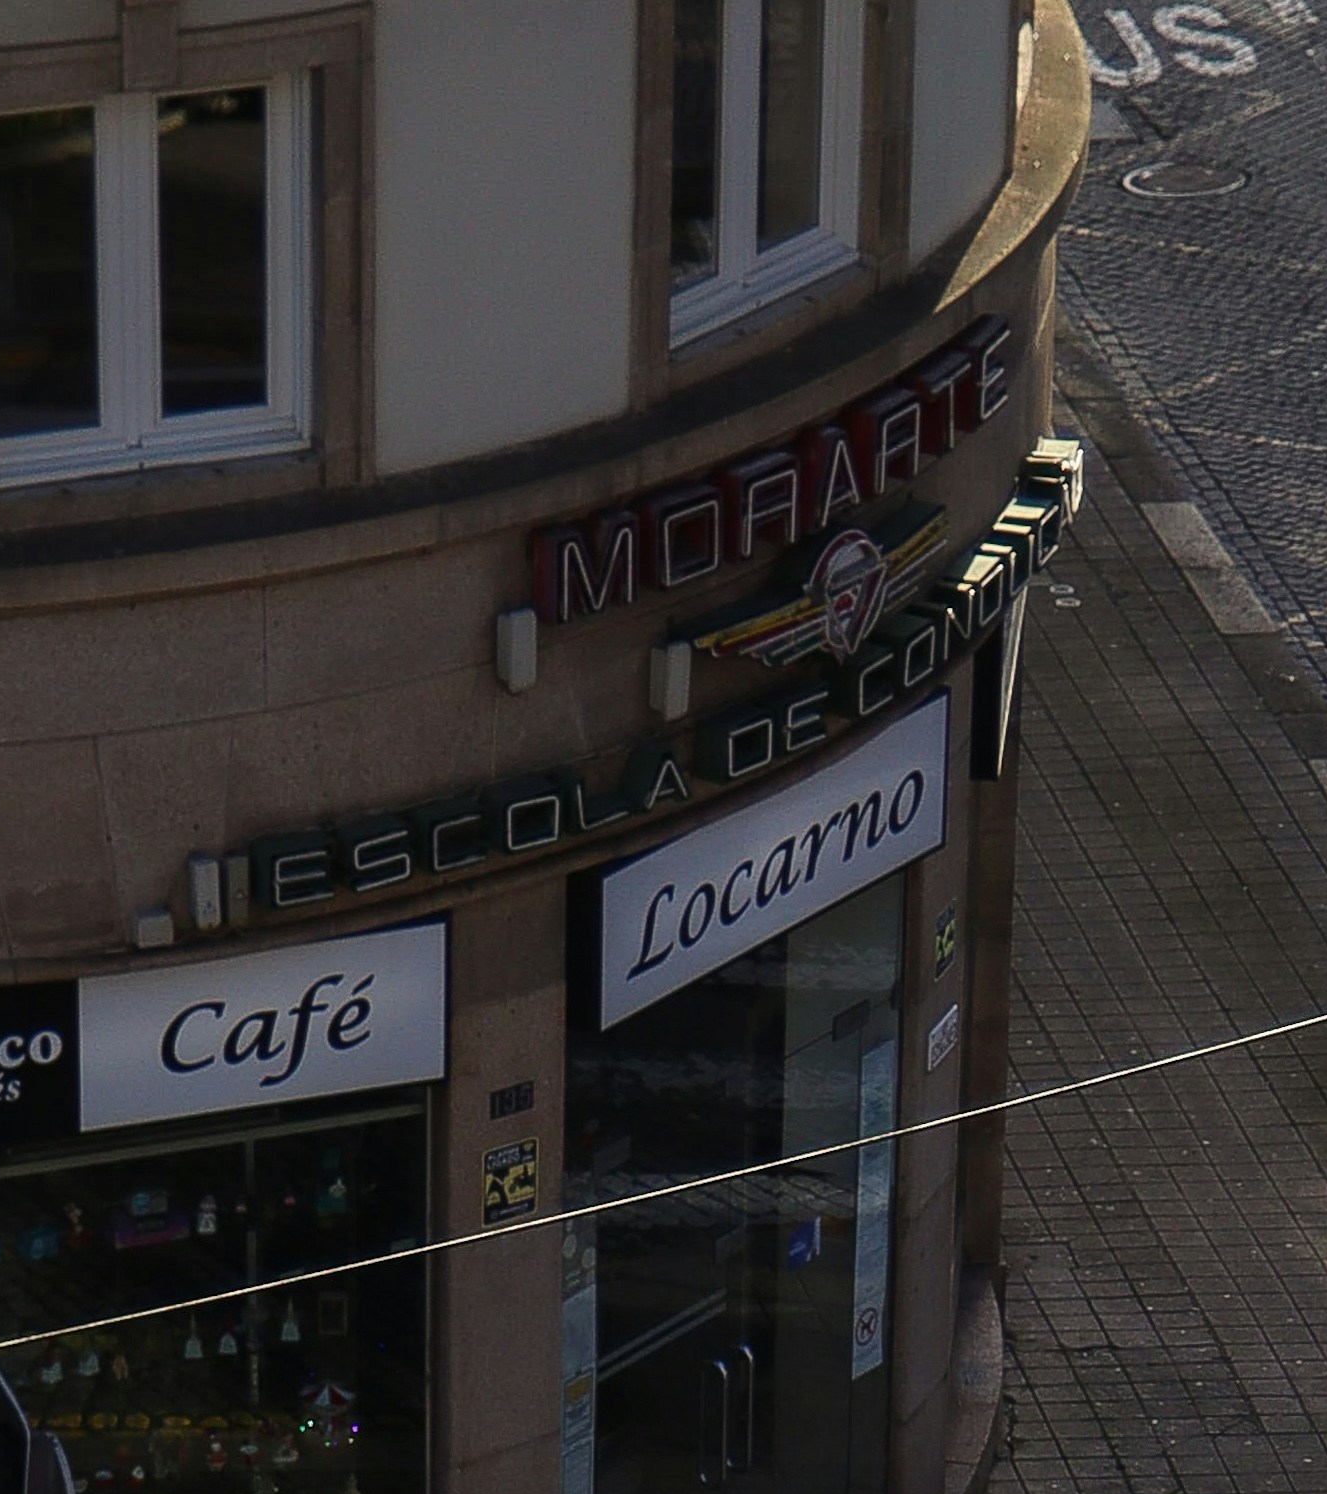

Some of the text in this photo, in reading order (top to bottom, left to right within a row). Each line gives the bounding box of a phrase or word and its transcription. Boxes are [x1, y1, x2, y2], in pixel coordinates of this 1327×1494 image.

[1085, 4, 1260, 86] US
[258, 742, 690, 908] ESCOLA
[710, 685, 828, 778] DE
[626, 769, 924, 982] Locarno
[160, 973, 375, 1088] Café
